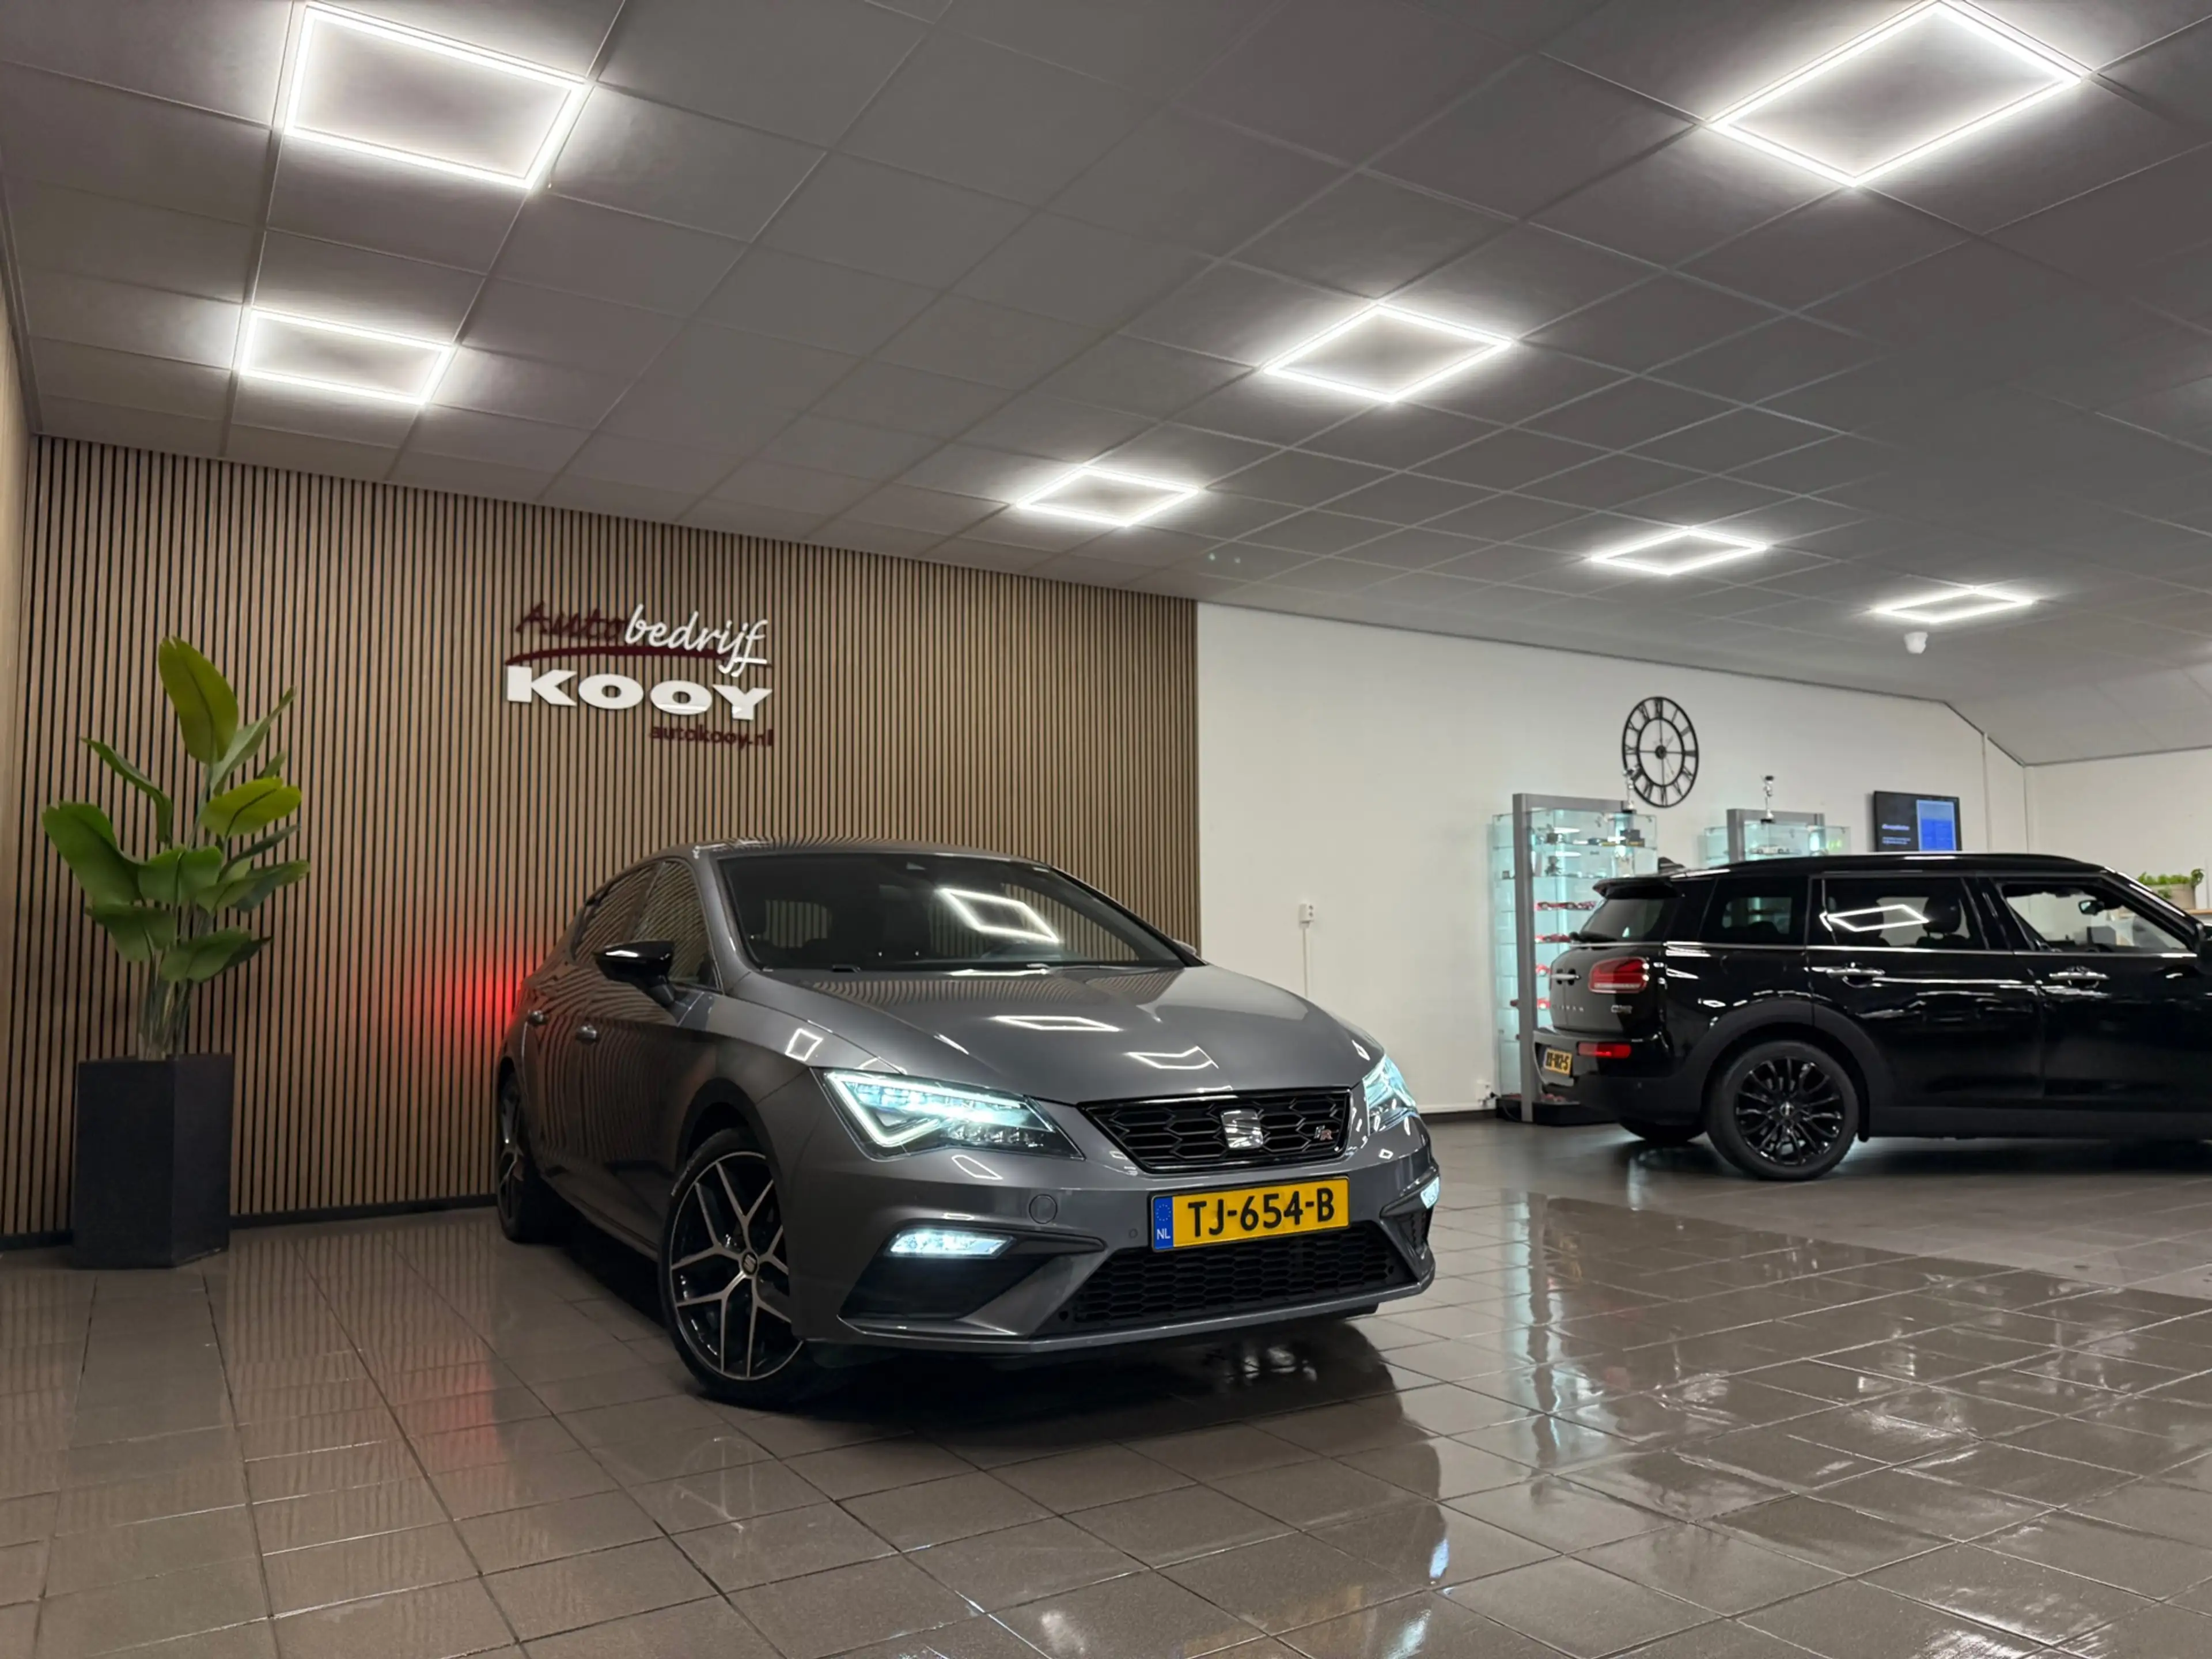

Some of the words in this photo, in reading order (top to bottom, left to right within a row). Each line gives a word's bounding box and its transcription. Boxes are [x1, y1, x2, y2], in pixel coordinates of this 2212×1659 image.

[515, 600, 769, 677] Autobedrijf
[506, 665, 773, 721] KOOY
[649, 725, 774, 750] autokooy.nl
[1156, 1228, 1171, 1240] NL
[1187, 1187, 1335, 1238] TJ-654-B
